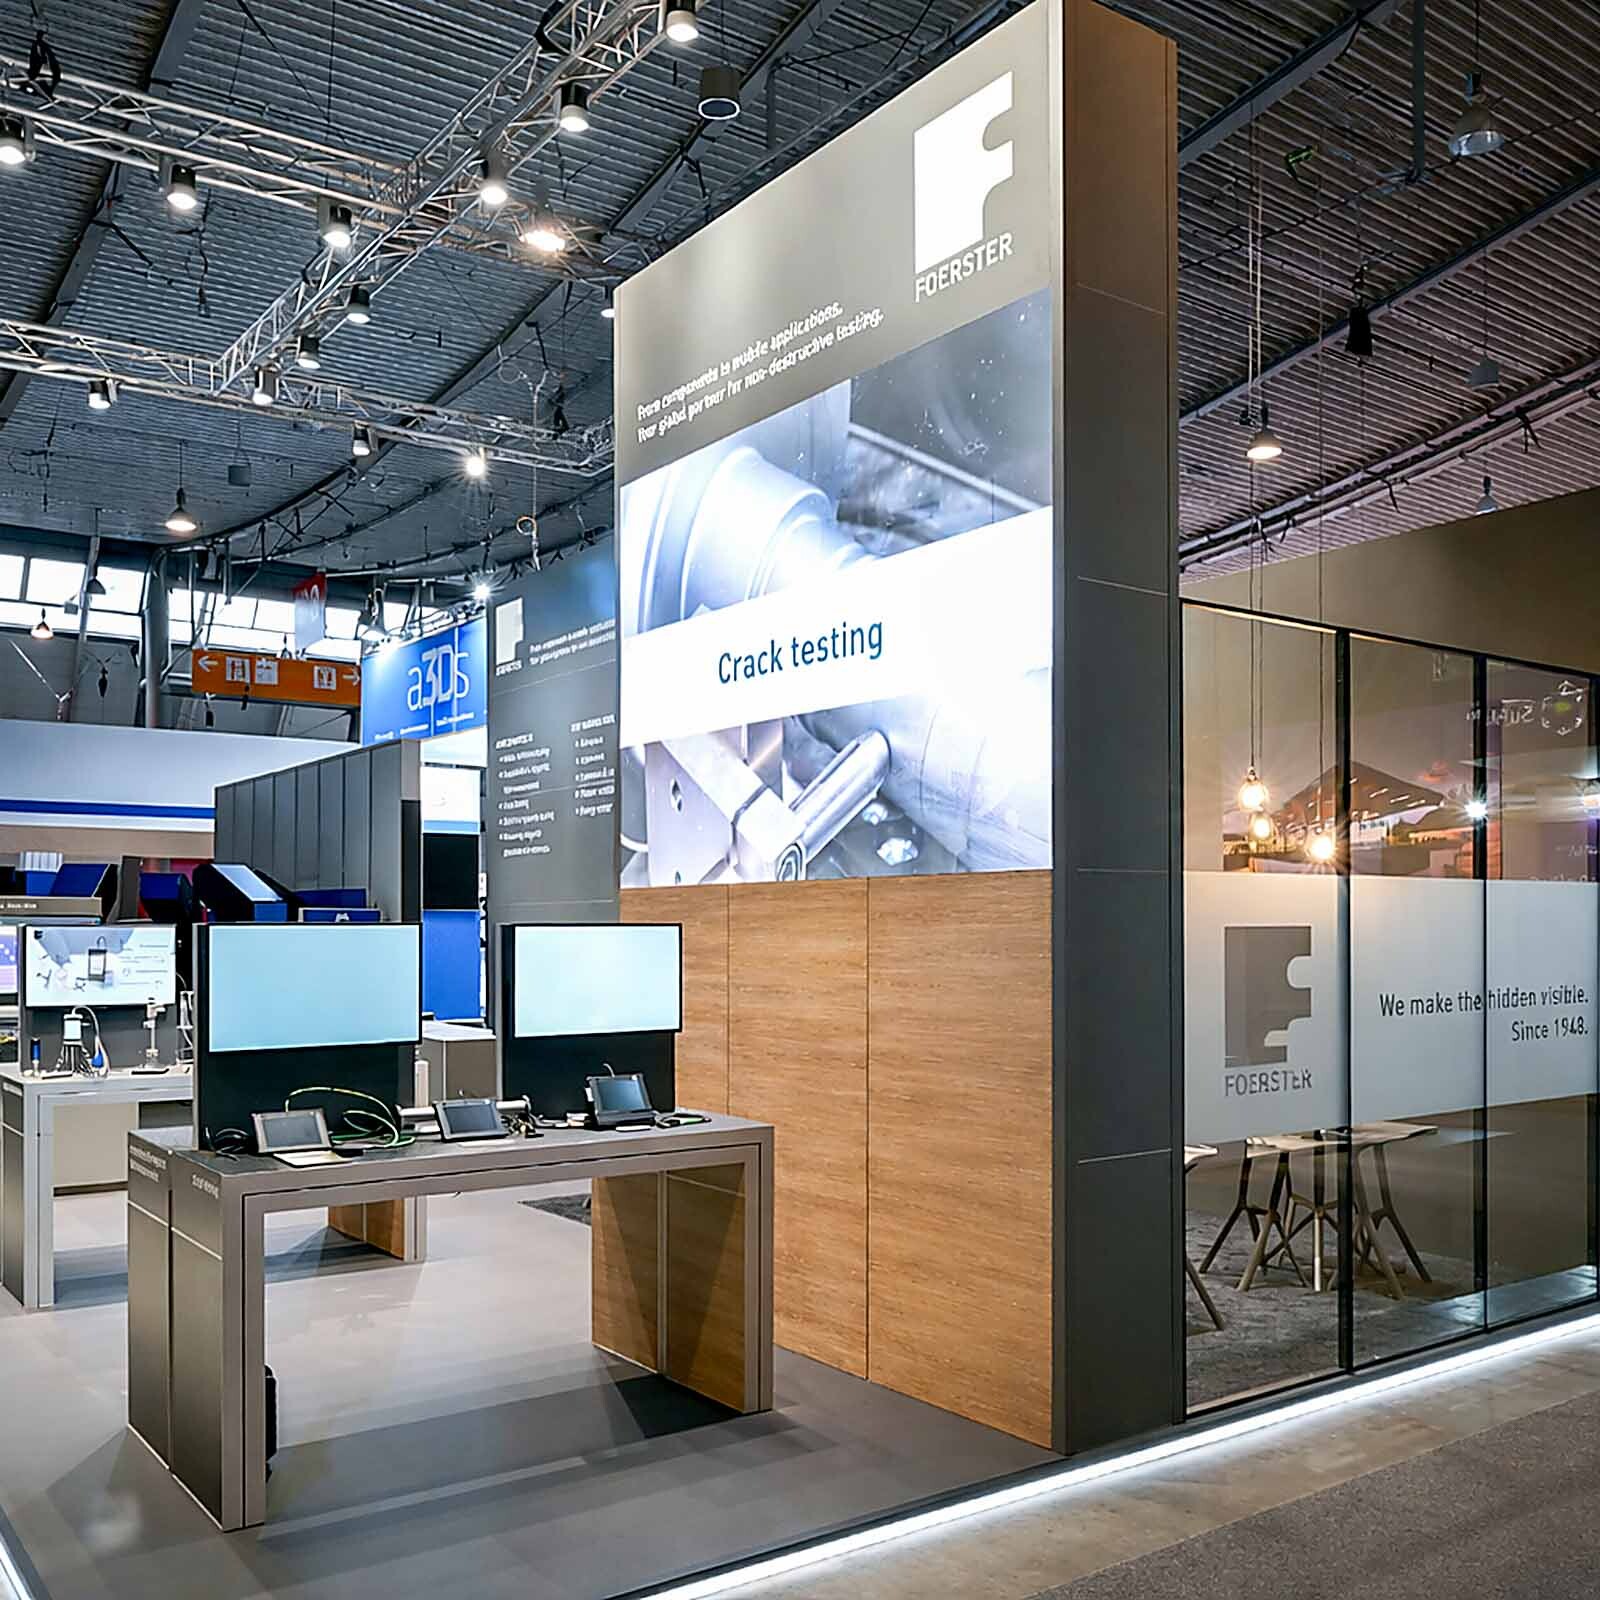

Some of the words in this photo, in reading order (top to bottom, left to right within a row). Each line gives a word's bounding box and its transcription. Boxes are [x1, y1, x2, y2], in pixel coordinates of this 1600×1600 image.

[915, 232, 1013, 303] FOERSTER
[718, 639, 783, 684] Crack
[791, 621, 882, 667] testing
[1379, 993, 1405, 1017] We
[1410, 991, 1453, 1015] make
[1457, 991, 1482, 1012] the
[1488, 987, 1536, 1009] hidden
[1541, 984, 1589, 1006] visible.
[1512, 1020, 1549, 1042] Since
[1554, 1016, 1589, 1037] 1948.
[1225, 1068, 1312, 1097] FOERSTER
